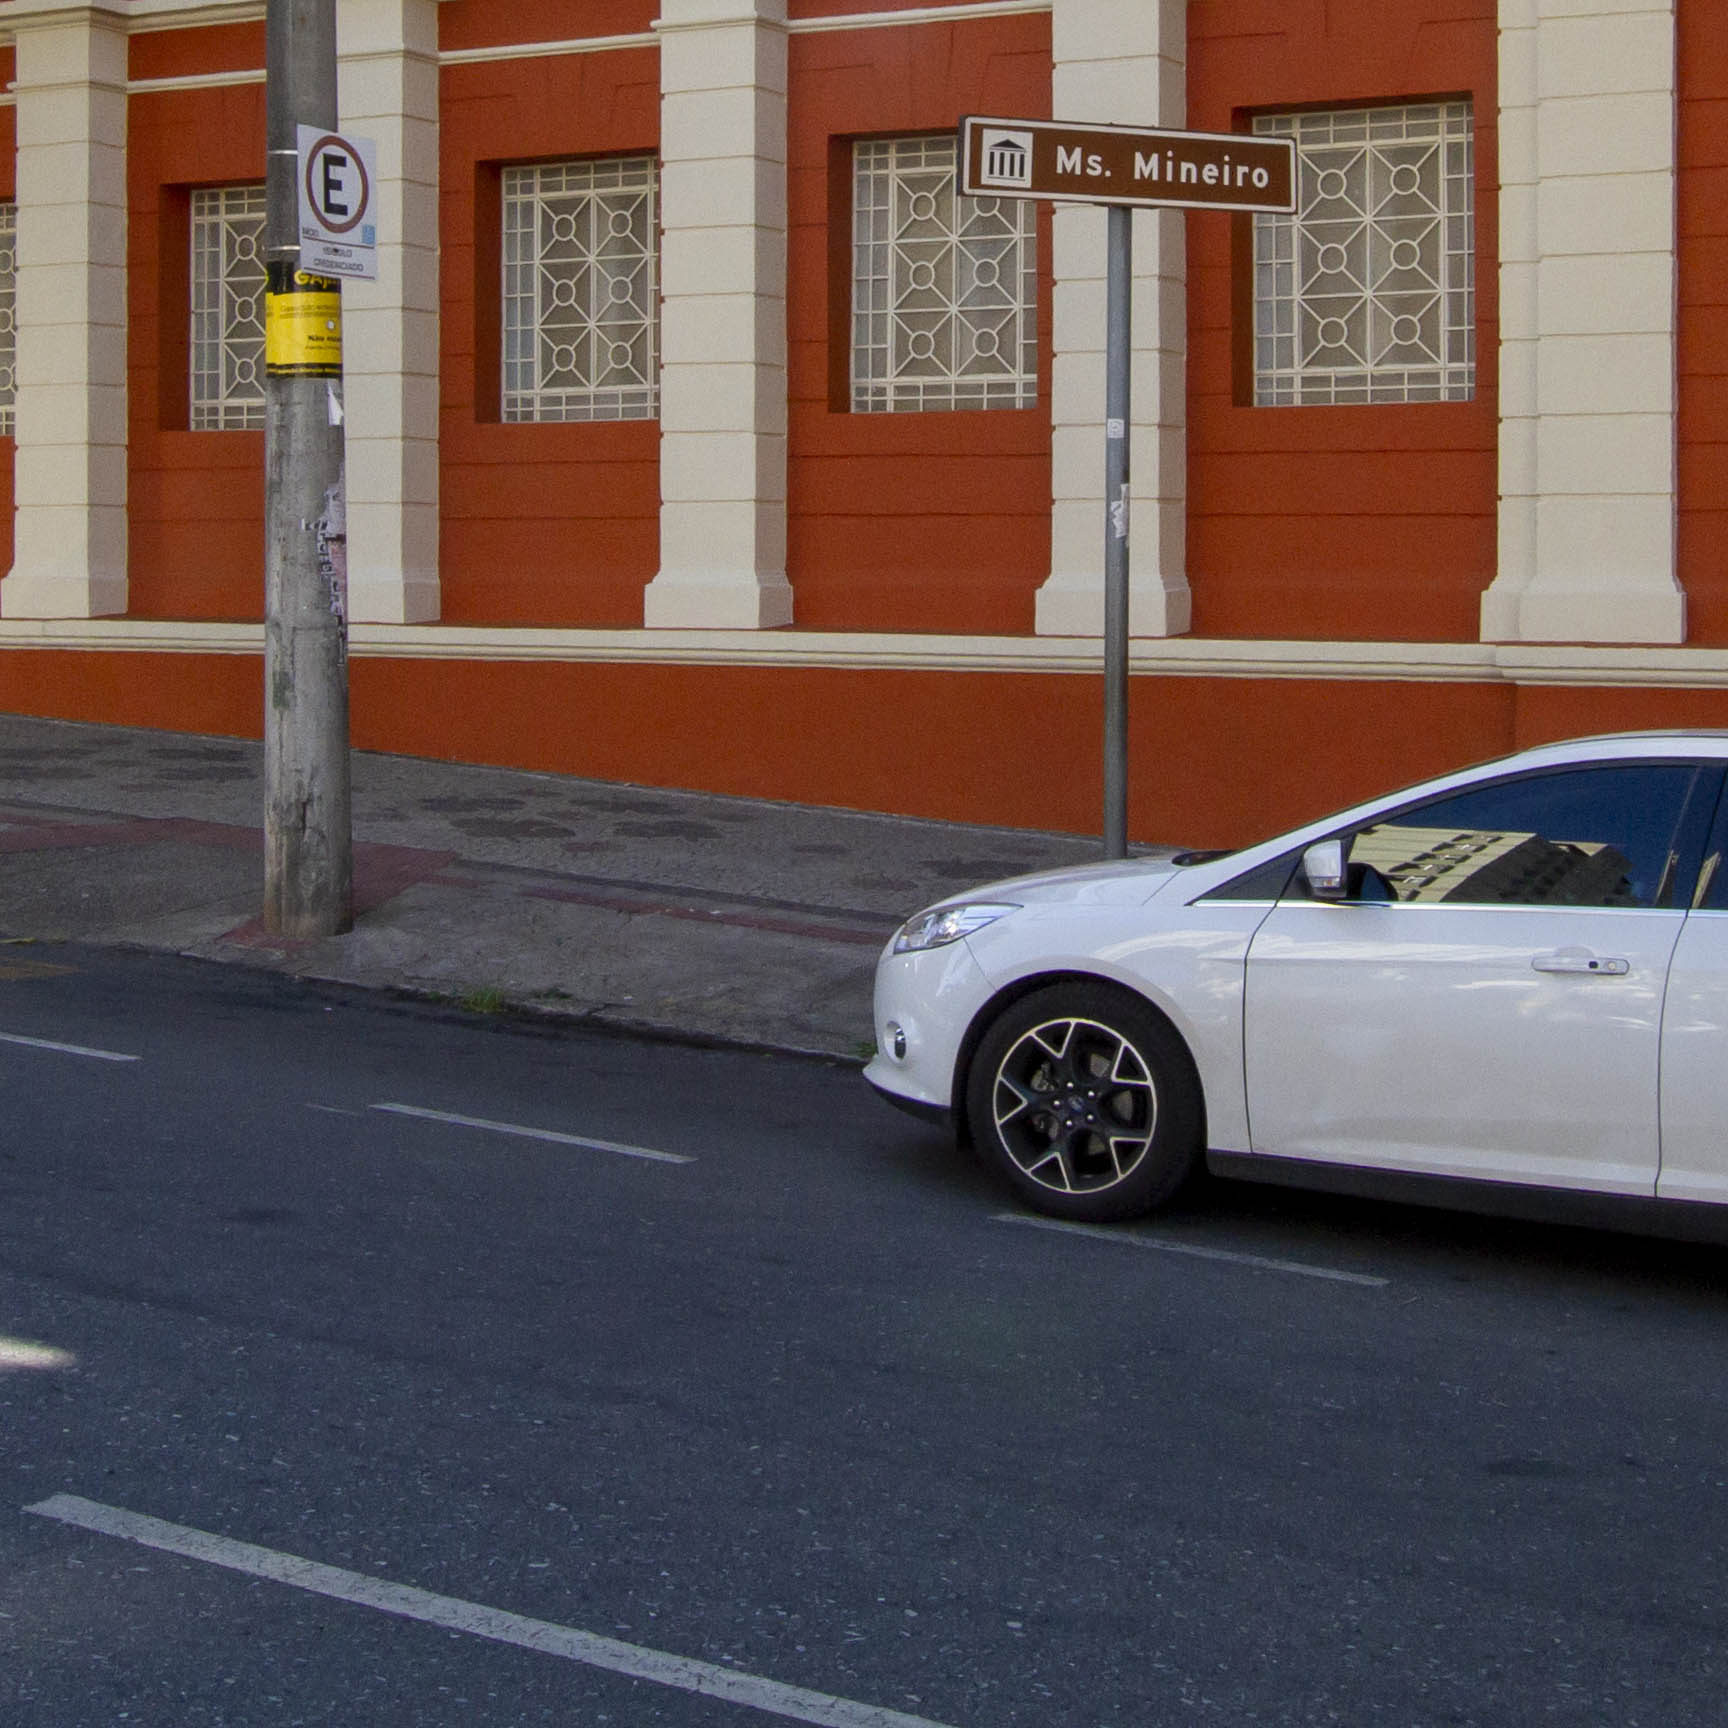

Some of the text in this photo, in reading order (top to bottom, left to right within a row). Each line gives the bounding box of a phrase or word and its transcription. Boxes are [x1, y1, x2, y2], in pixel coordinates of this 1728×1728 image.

[323, 153, 348, 216] E
[1055, 145, 1270, 189] Ms. Mineiro
